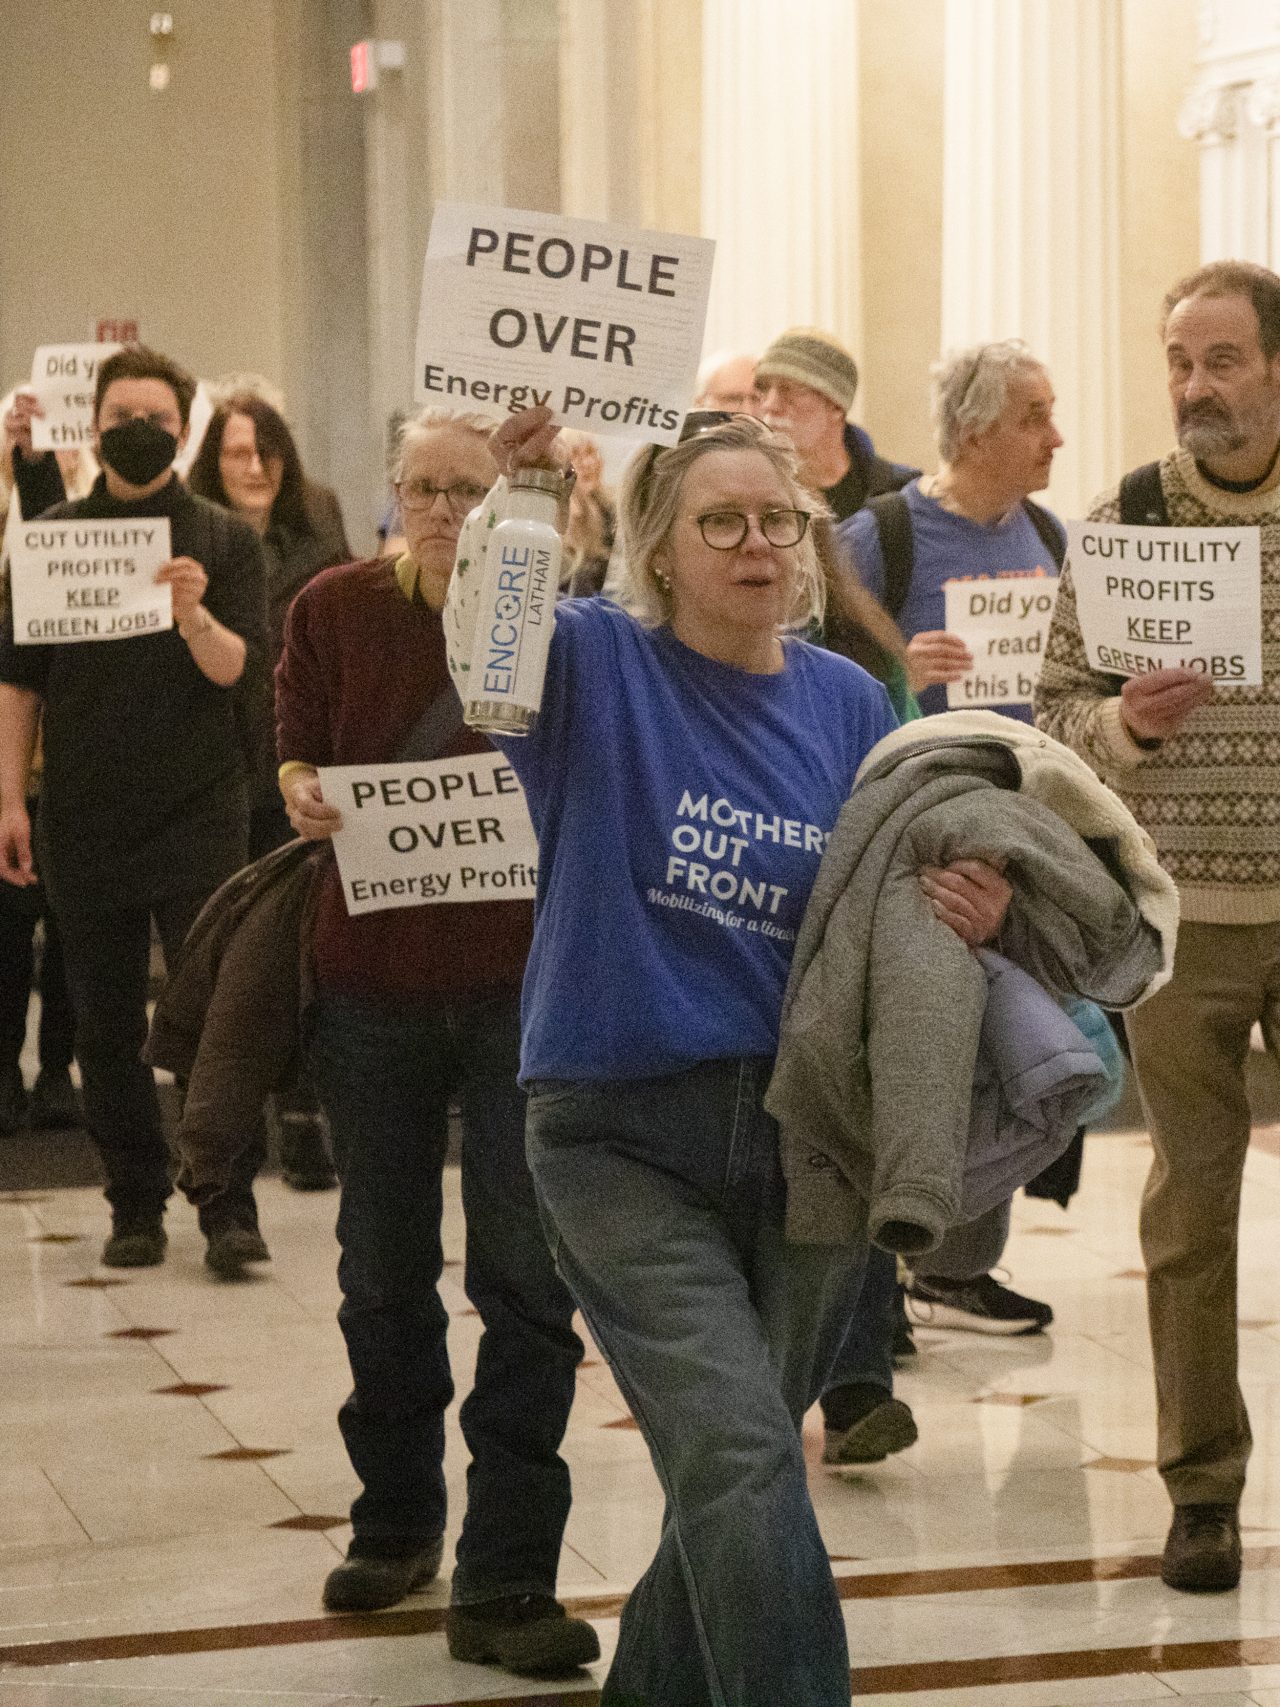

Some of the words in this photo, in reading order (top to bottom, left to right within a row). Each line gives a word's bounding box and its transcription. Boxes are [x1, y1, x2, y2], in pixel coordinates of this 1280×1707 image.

[466, 226, 680, 298] PEOPLE
[489, 308, 637, 367] OVER
[46, 355, 78, 377] Did
[423, 364, 552, 414] Energy
[561, 385, 680, 431] Profits
[25, 530, 68, 549] CUT
[75, 528, 156, 548] UTILITY
[1081, 535, 1129, 559] CUT
[1137, 541, 1241, 562] UTILITY
[47, 558, 136, 578] PROFITS
[67, 588, 120, 608] KEEP
[527, 549, 551, 626] LATHAM
[1106, 576, 1214, 601] PROFITS
[483, 545, 530, 694] ENCORE
[969, 591, 1012, 617] Did
[1018, 594, 1052, 619] yo
[27, 618, 99, 638] GREEN
[106, 610, 160, 632] JOBS
[1127, 616, 1193, 644] KEEP
[987, 630, 1042, 655] read
[1096, 645, 1162, 674] GREEN
[964, 675, 1009, 698] this
[351, 766, 520, 809] PEOPLE
[388, 817, 505, 853] OVER
[672, 824, 748, 866] OUT
[350, 872, 451, 901] Energy
[460, 863, 537, 889] Profit
[666, 856, 788, 914] FRONT
[647, 888, 725, 925] Mobilizing
[747, 920, 758, 932] a
